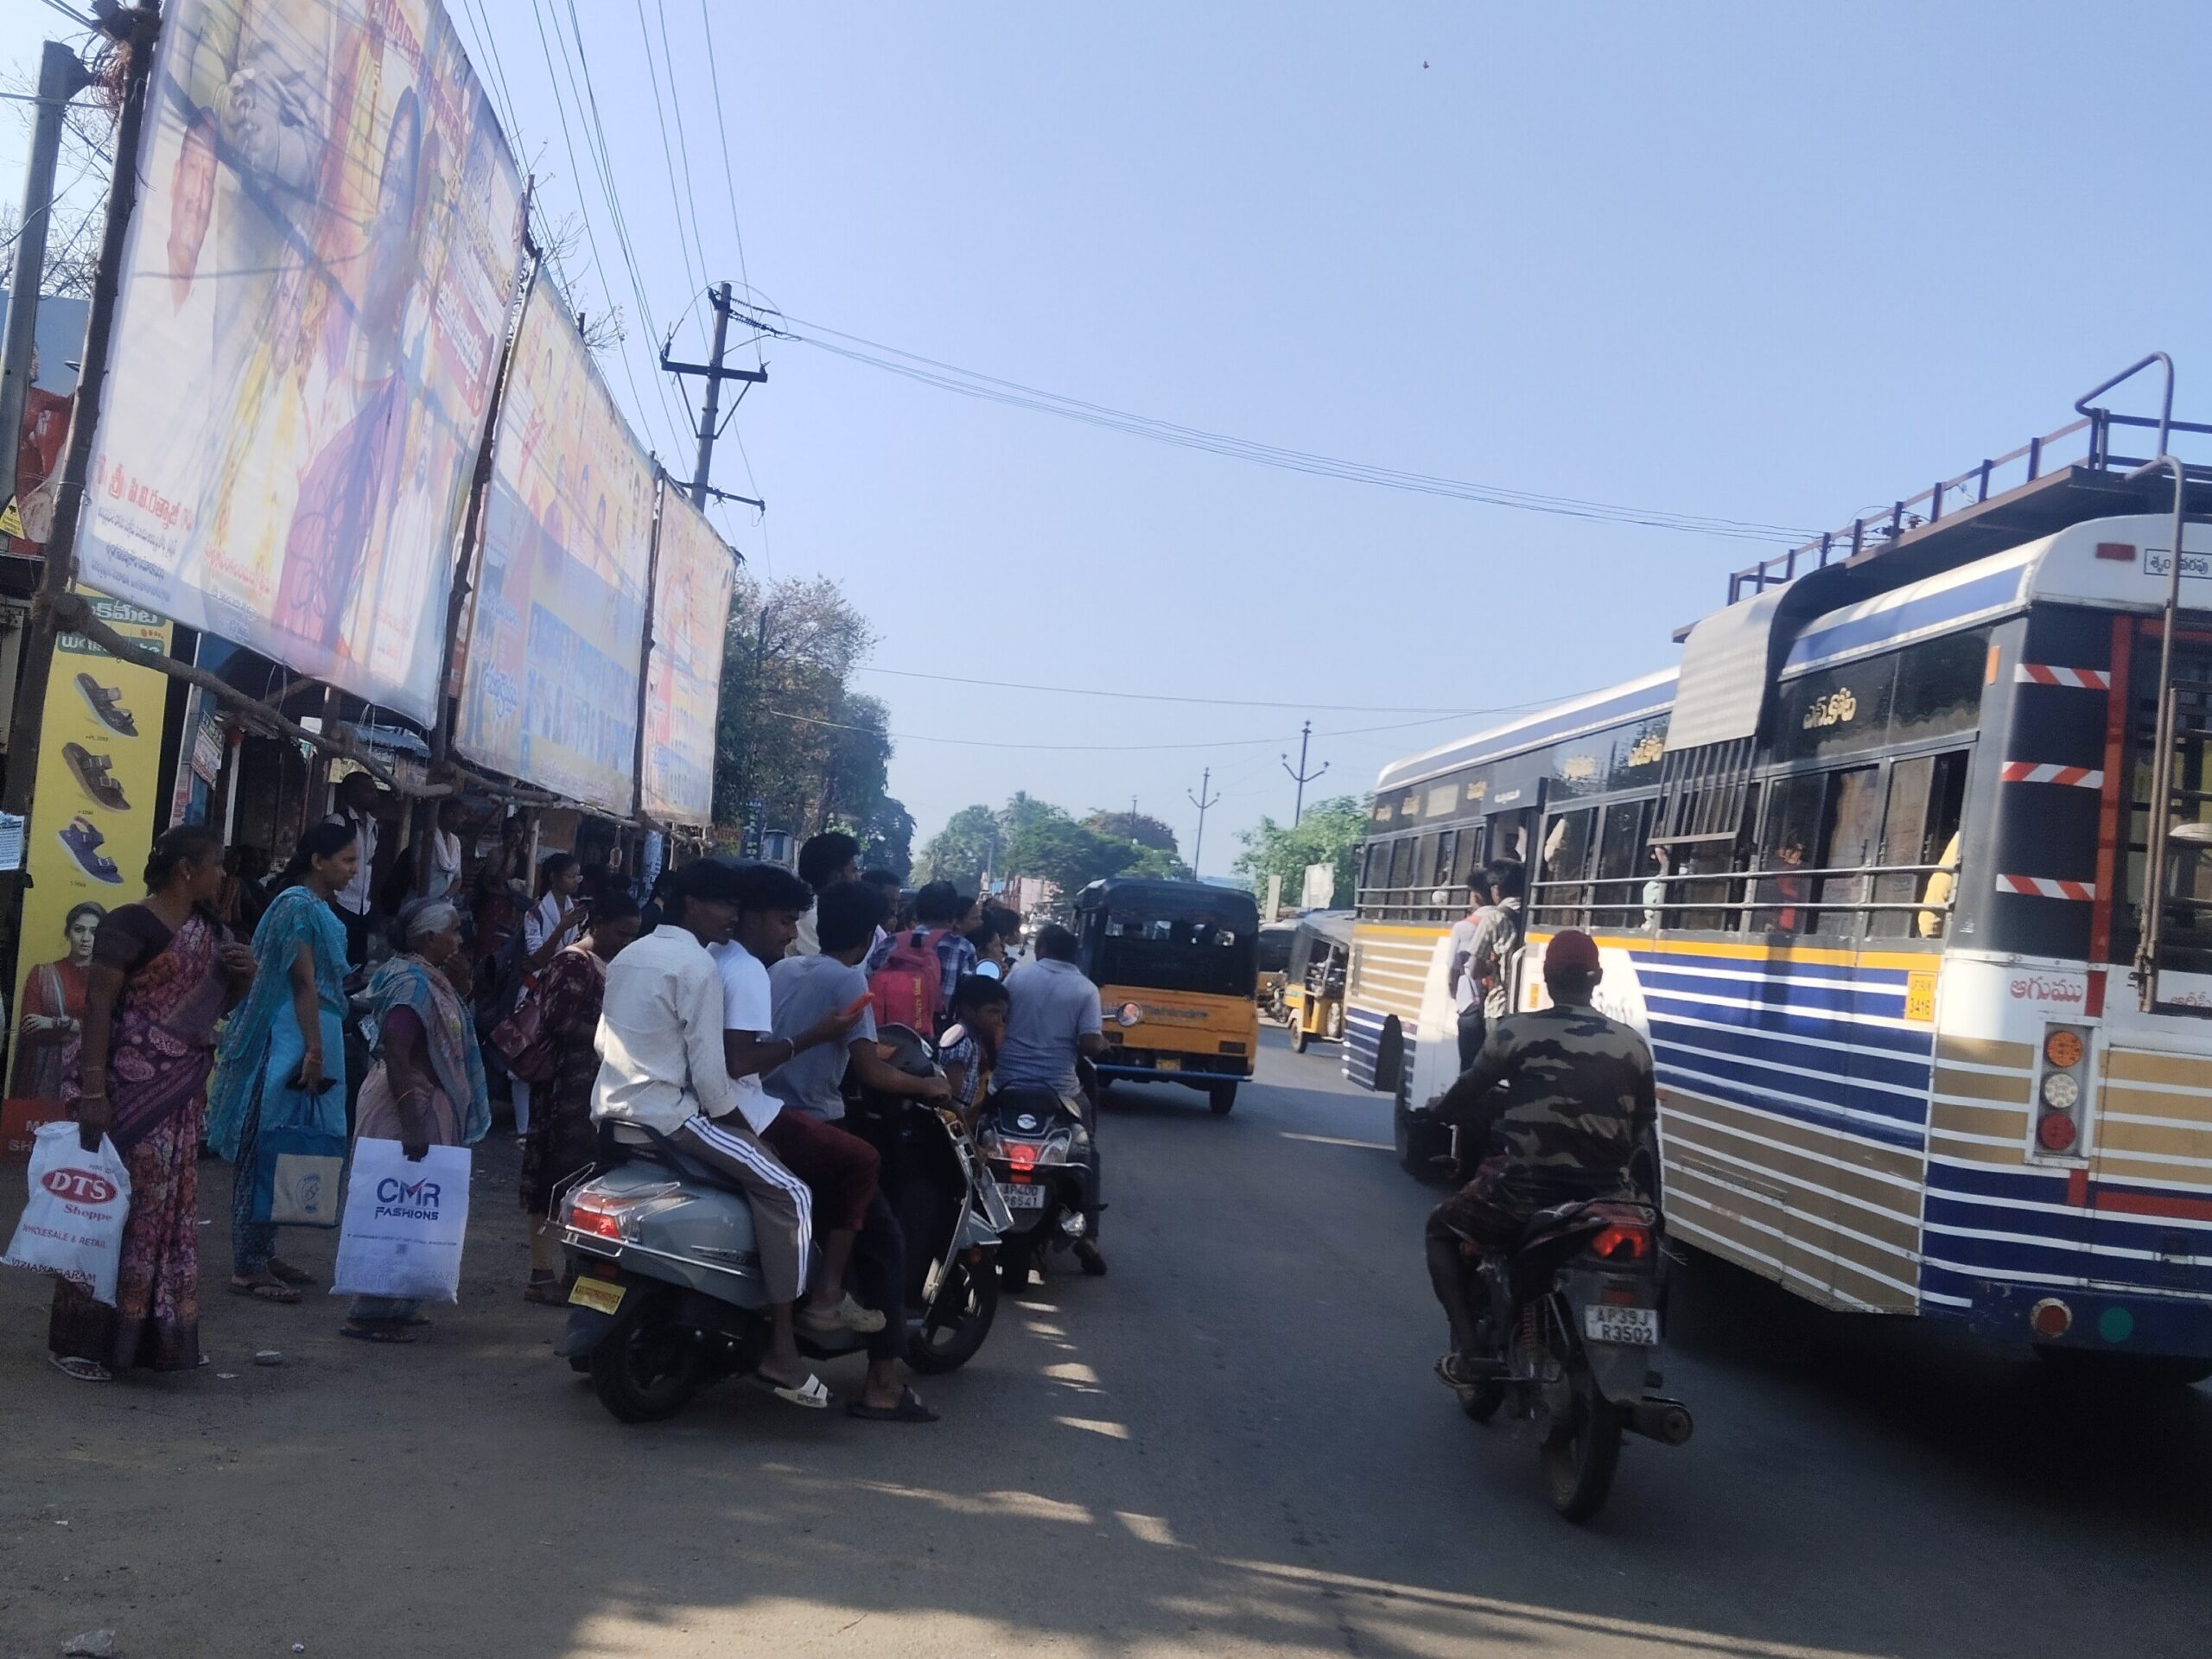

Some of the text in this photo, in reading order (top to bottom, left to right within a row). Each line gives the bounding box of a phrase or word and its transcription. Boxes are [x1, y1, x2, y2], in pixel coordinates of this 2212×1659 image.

[2010, 976, 2083, 1003] ఆగుము
[49, 1172, 107, 1200] DTS
[376, 1176, 442, 1208] CMR
[63, 1203, 112, 1223] Shoppe
[374, 1206, 440, 1221] FASHIONS
